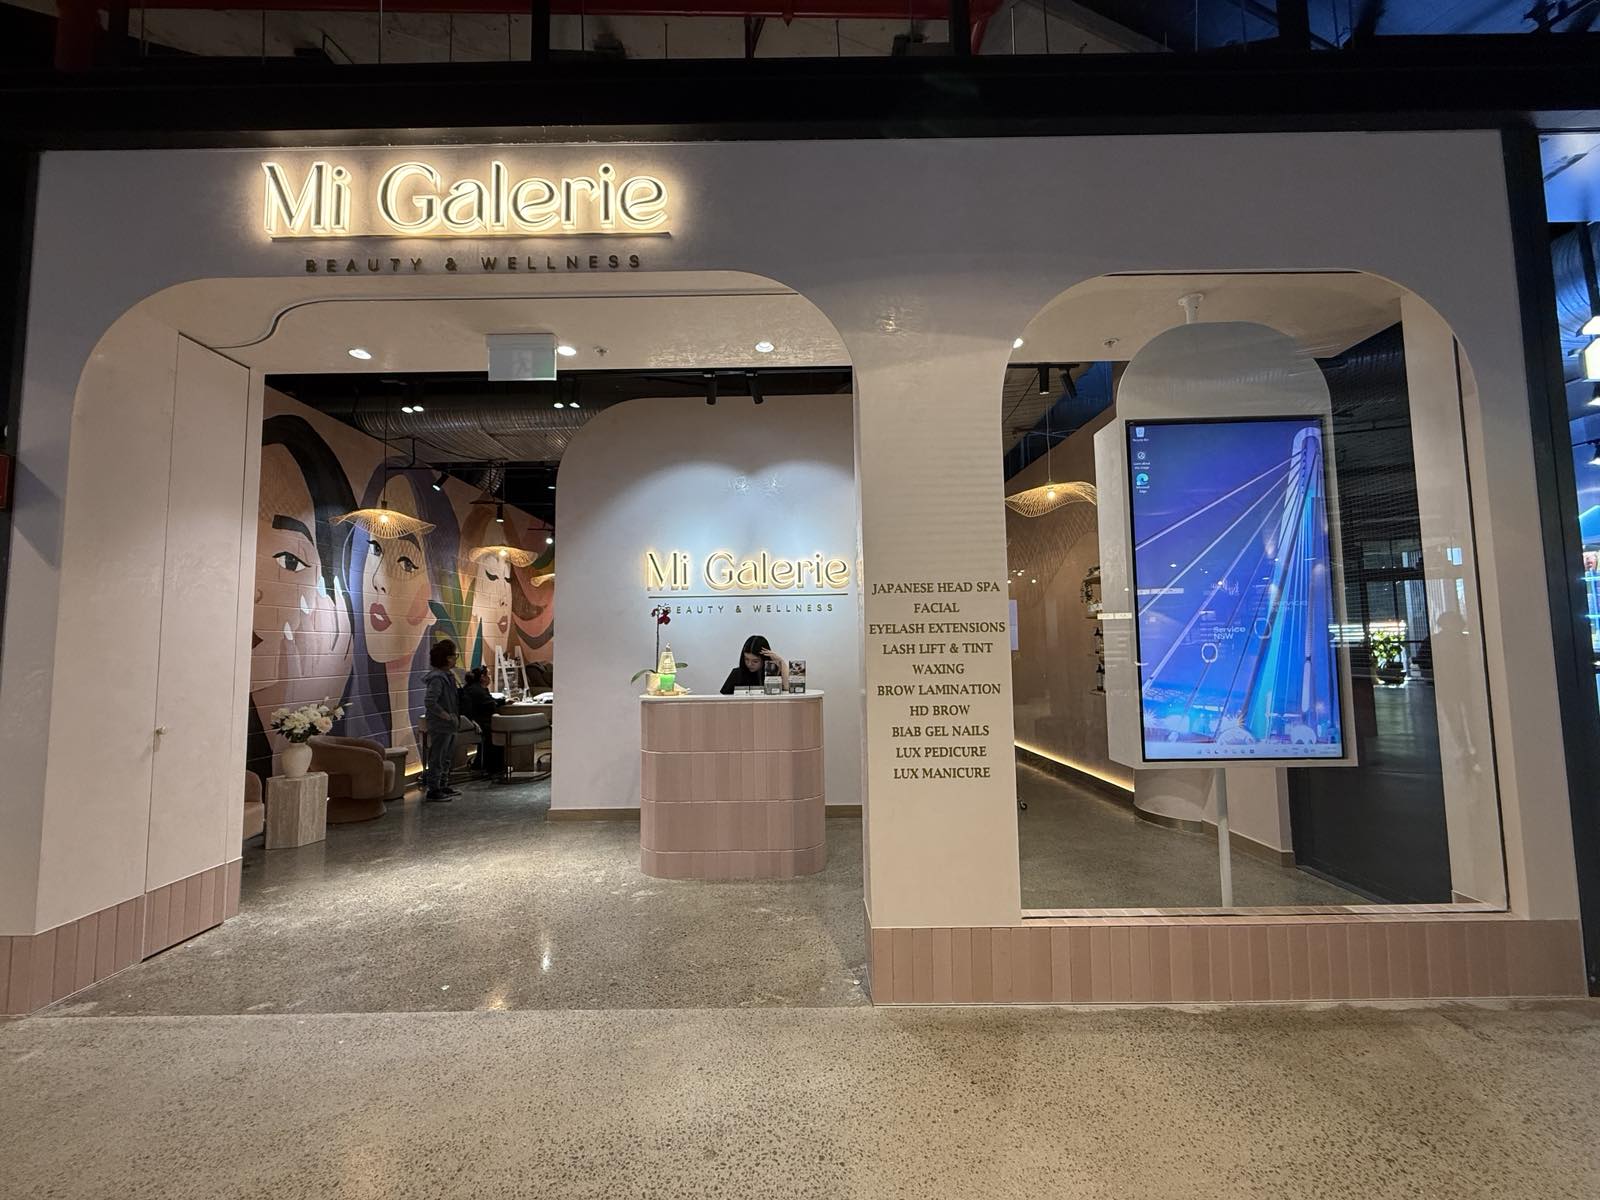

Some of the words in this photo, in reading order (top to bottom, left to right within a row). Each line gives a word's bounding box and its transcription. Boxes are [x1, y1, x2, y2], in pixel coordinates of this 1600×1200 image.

[262, 161, 351, 234] Mi
[377, 160, 668, 234] Galerie
[305, 257, 422, 273] BEAUTY
[444, 257, 459, 272] &
[481, 254, 641, 271] WELLNESS
[646, 550, 690, 591] Mi
[704, 550, 850, 591] Galerie
[871, 582, 934, 596] JAPANESE
[937, 581, 973, 593] HEAD
[976, 581, 1001, 593] SPA
[735, 605, 743, 614] &
[752, 603, 834, 614] WELLNESS
[913, 602, 960, 614] FACIAL
[868, 623, 925, 635] EYELASH
[927, 621, 1006, 634] EXTENSIONS
[882, 643, 916, 655] LASH
[918, 643, 946, 655] LIFT
[949, 642, 959, 654] &
[961, 642, 994, 654] TINT
[911, 663, 965, 675] WAXING
[877, 684, 916, 696] BROW
[918, 683, 1001, 696] LAMINATION
[909, 705, 929, 717] HD
[932, 704, 971, 716] BROW
[891, 726, 922, 738] BIAB
[925, 725, 949, 737] GEL
[951, 724, 990, 737] NAILS
[895, 747, 922, 759] LUX
[924, 745, 988, 758] PEDICURE
[893, 767, 919, 780] LUX
[921, 766, 991, 779] MANICURE
